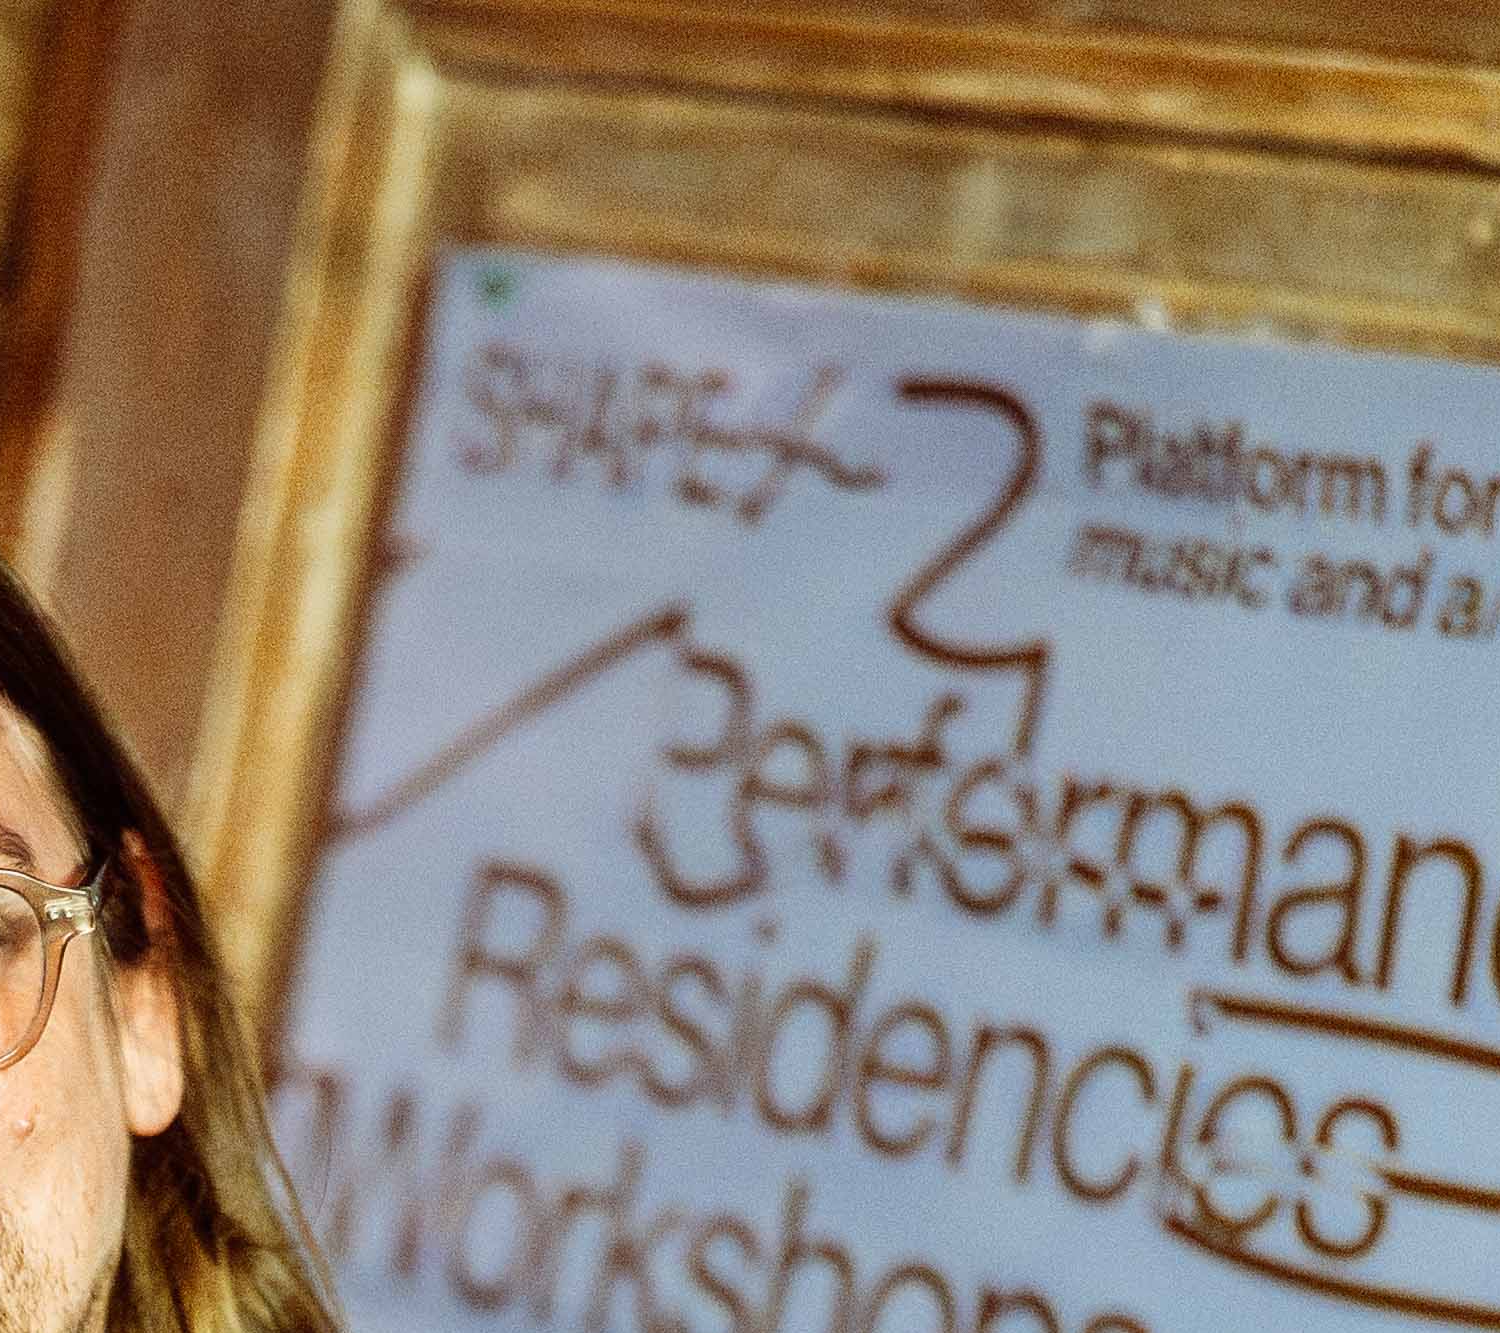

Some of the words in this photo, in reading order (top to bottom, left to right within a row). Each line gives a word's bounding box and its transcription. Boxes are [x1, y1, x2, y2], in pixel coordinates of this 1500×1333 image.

[1079, 400, 1391, 534] Platform
[1072, 520, 1275, 615] music
[1287, 540, 1426, 633] and
